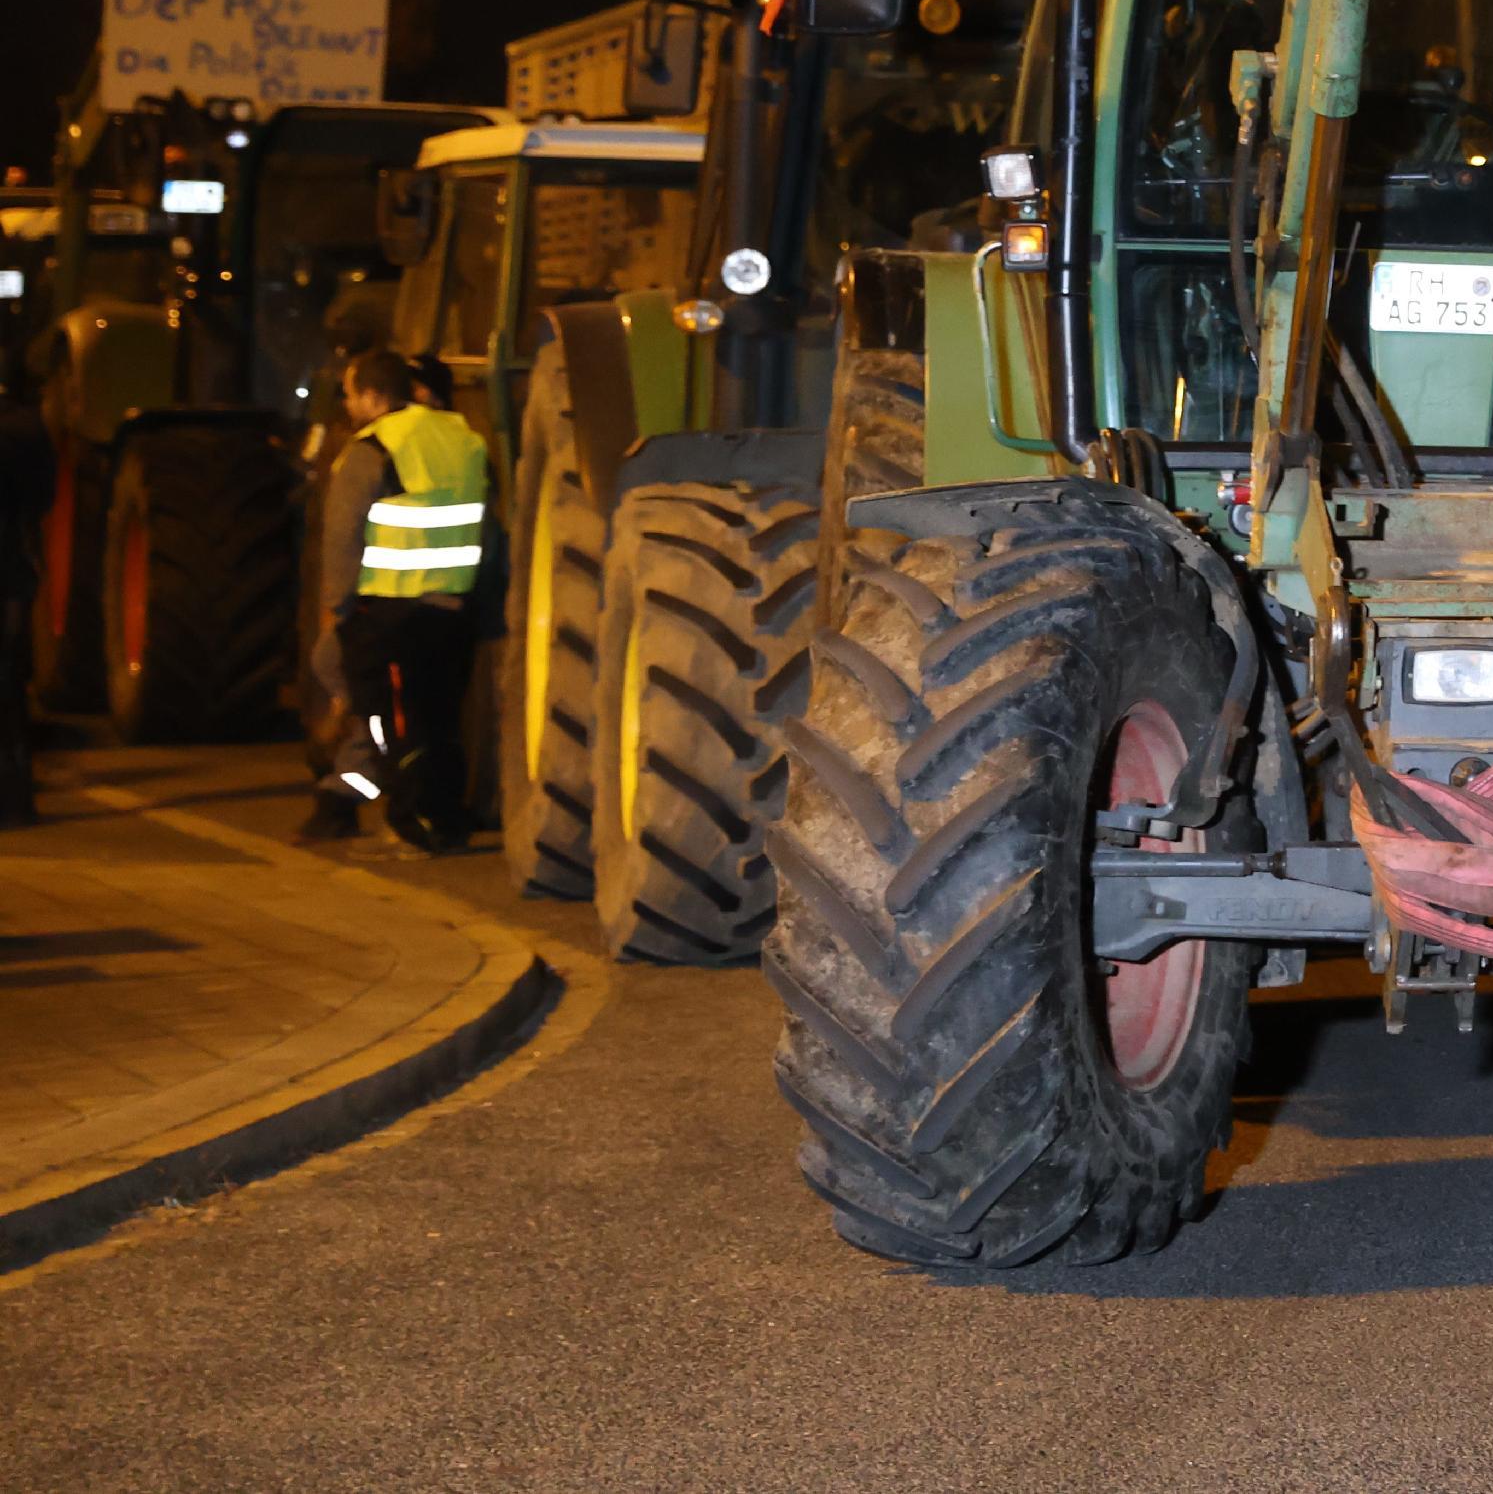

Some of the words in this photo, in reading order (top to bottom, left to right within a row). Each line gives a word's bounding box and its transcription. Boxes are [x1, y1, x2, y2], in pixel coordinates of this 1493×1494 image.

[1409, 270, 1444, 295] RH
[1389, 300, 1422, 325] AG
[1436, 301, 1487, 327] 753
